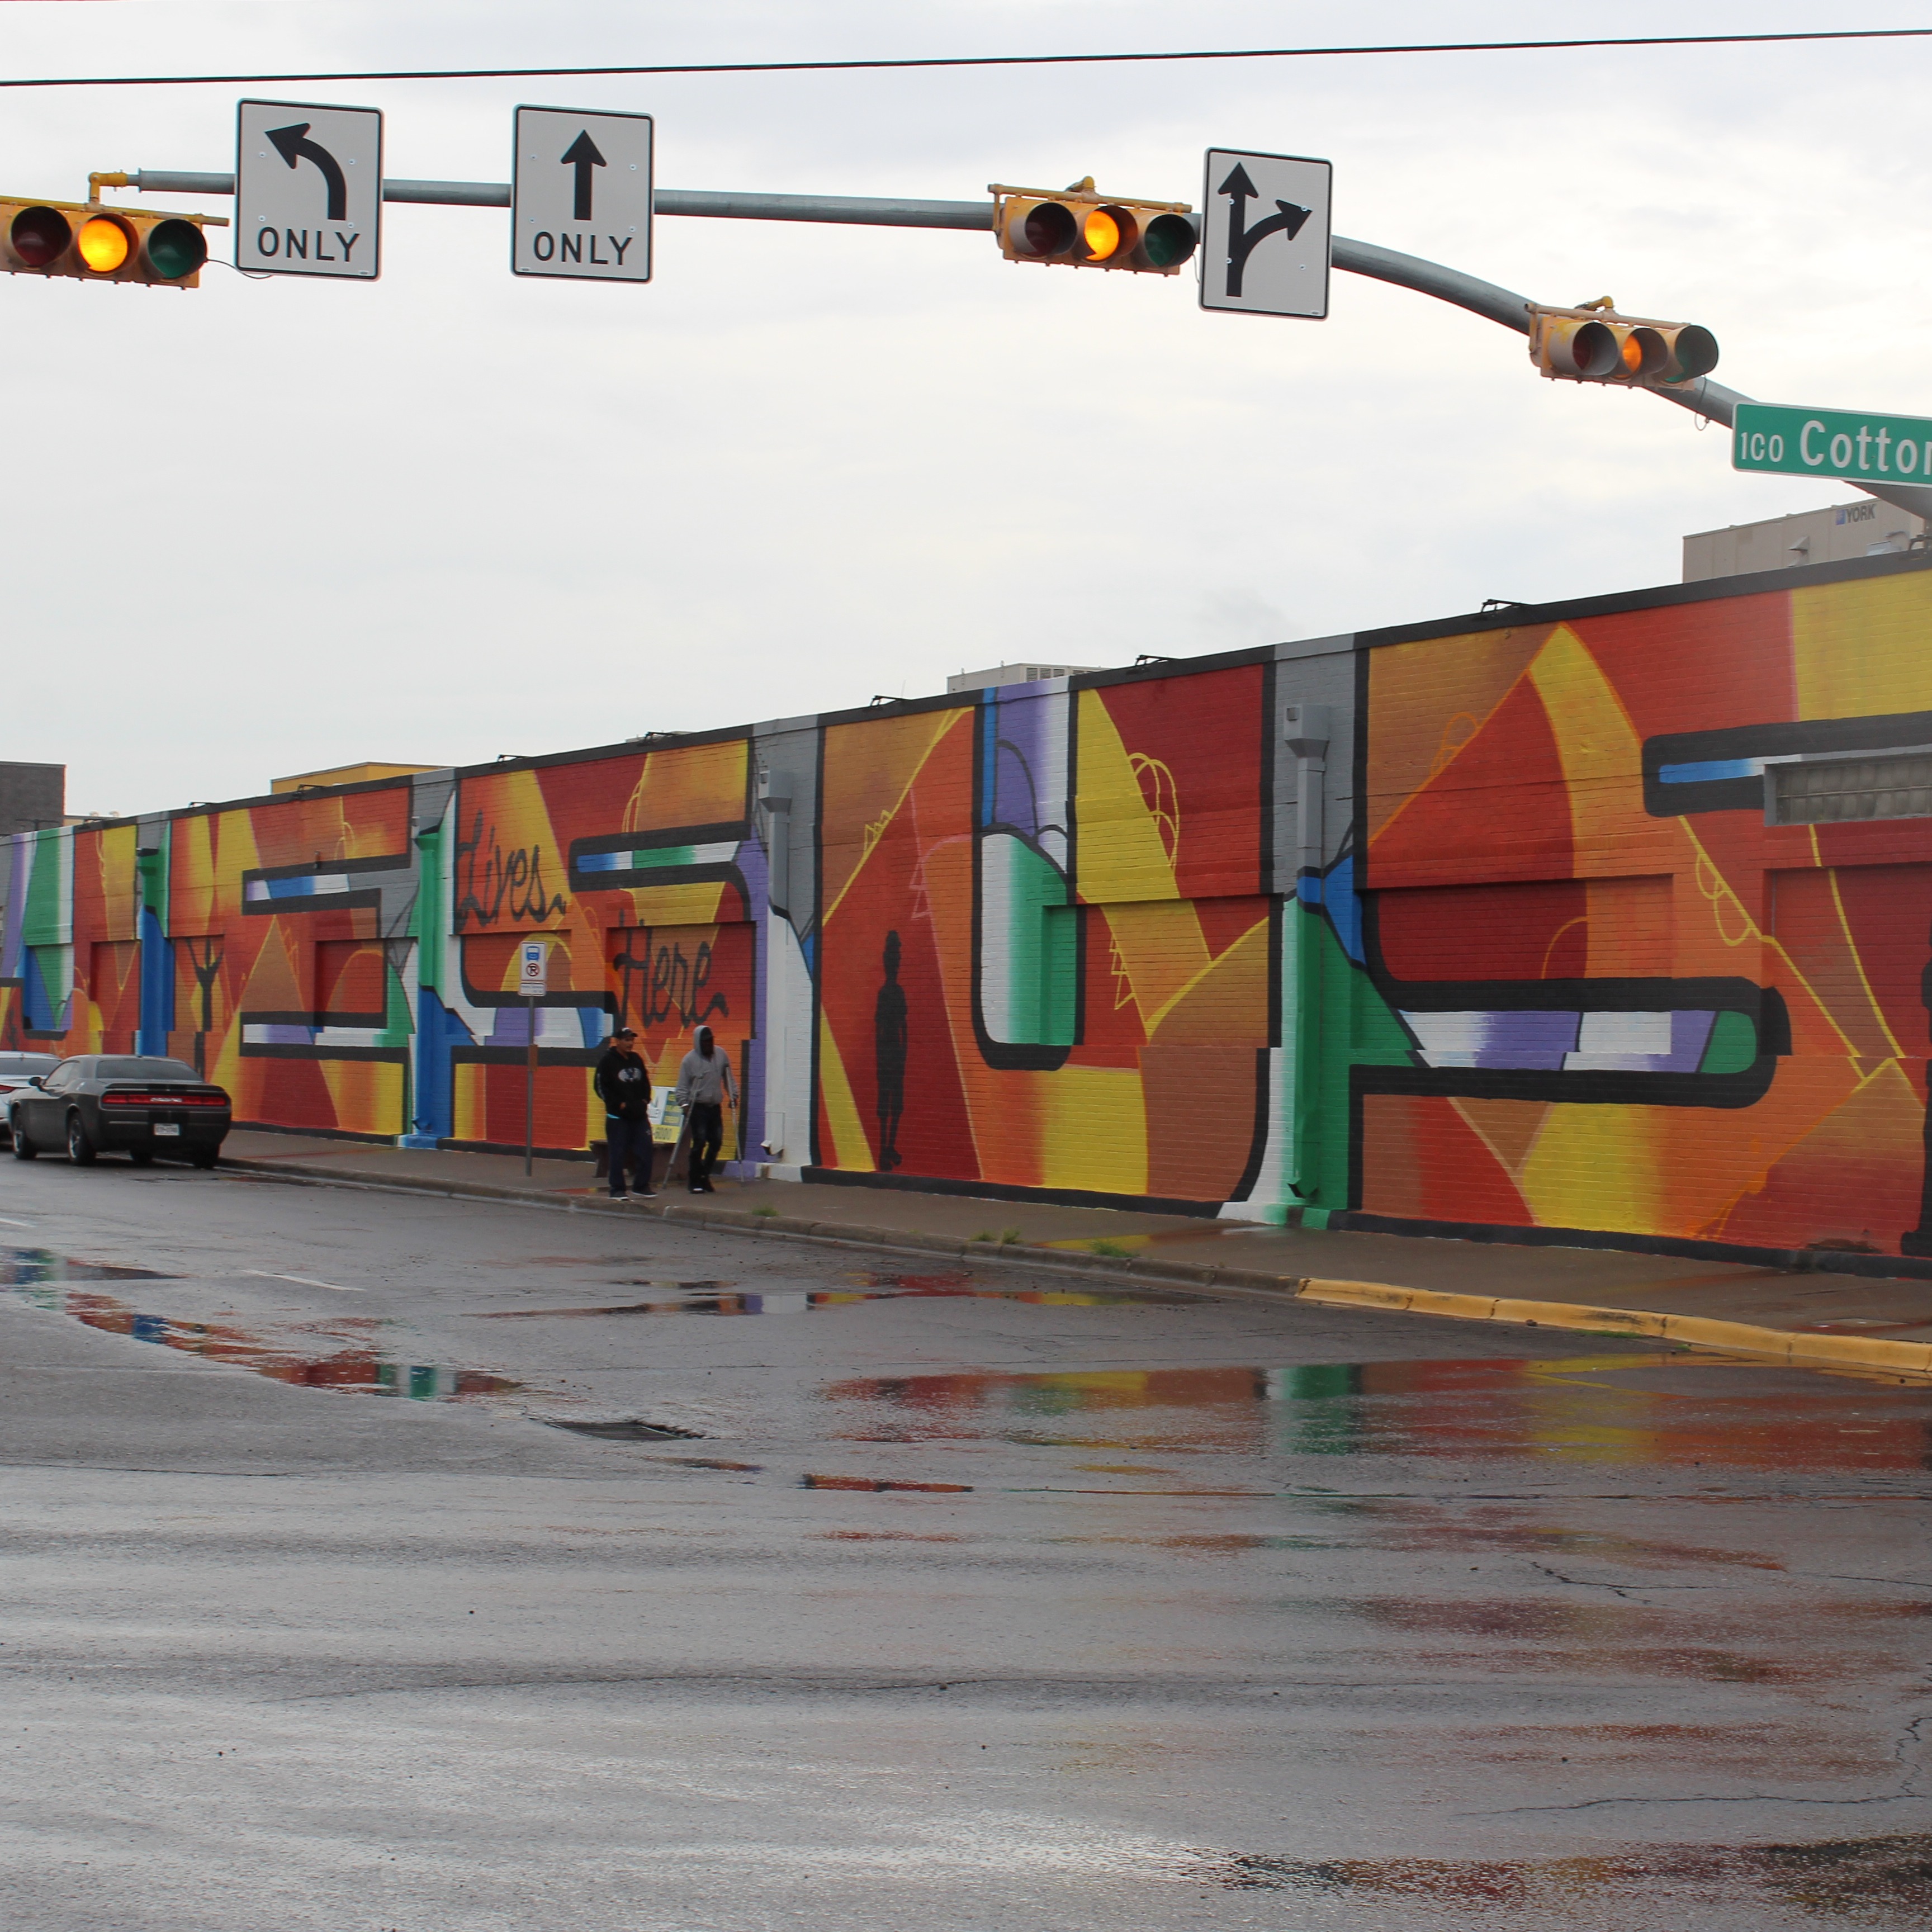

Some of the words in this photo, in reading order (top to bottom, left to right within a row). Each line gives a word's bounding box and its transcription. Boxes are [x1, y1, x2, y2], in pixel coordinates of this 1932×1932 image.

[258, 227, 359, 262] ONLY
[533, 231, 632, 266] ONLY
[1846, 504, 1877, 523] YORK
[455, 809, 566, 932] Lives
[613, 908, 730, 1030] Here
